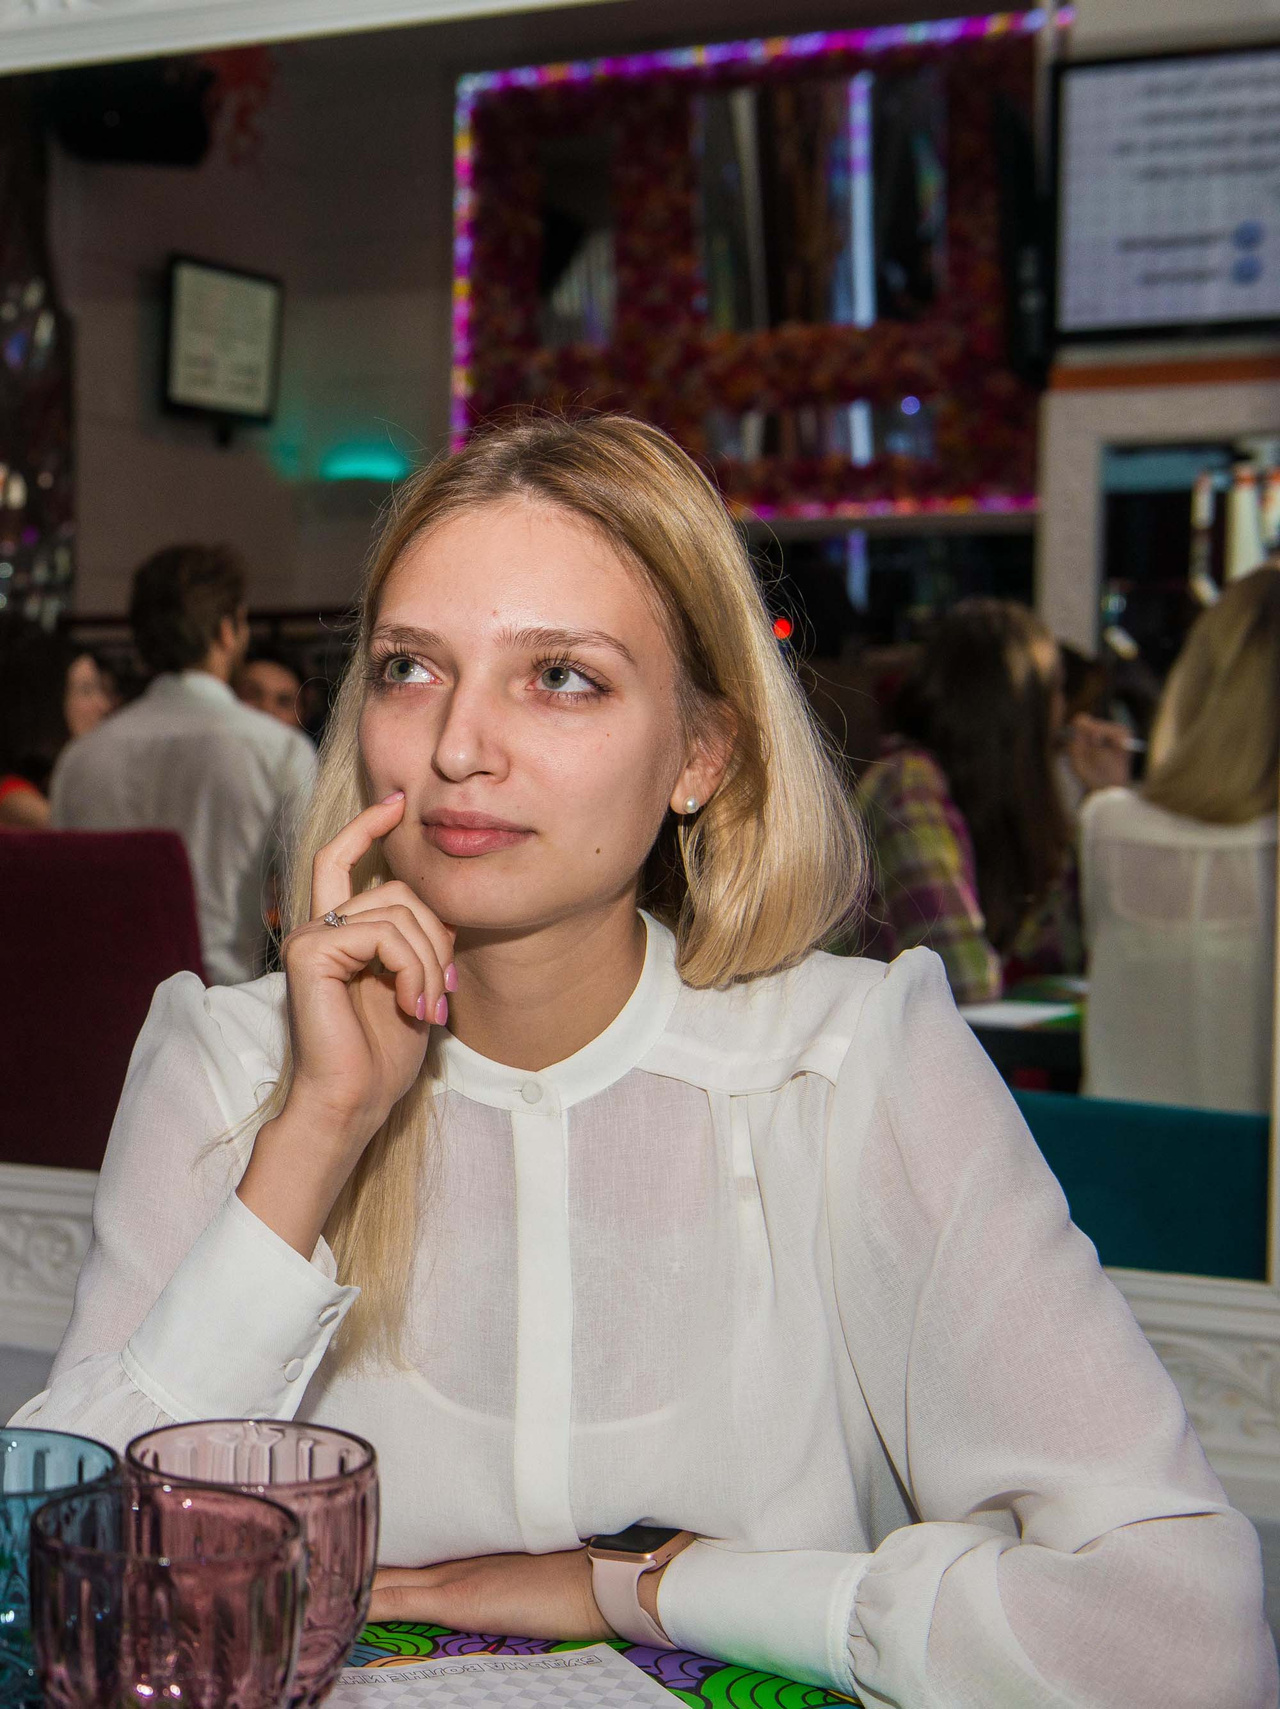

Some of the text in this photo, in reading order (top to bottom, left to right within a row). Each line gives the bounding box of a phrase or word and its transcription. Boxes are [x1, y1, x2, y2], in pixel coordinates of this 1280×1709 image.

[483, 1661, 528, 1671] НА
[528, 1654, 603, 1670] БУДЬ
[387, 1663, 485, 1683] ВОЛНЕ
